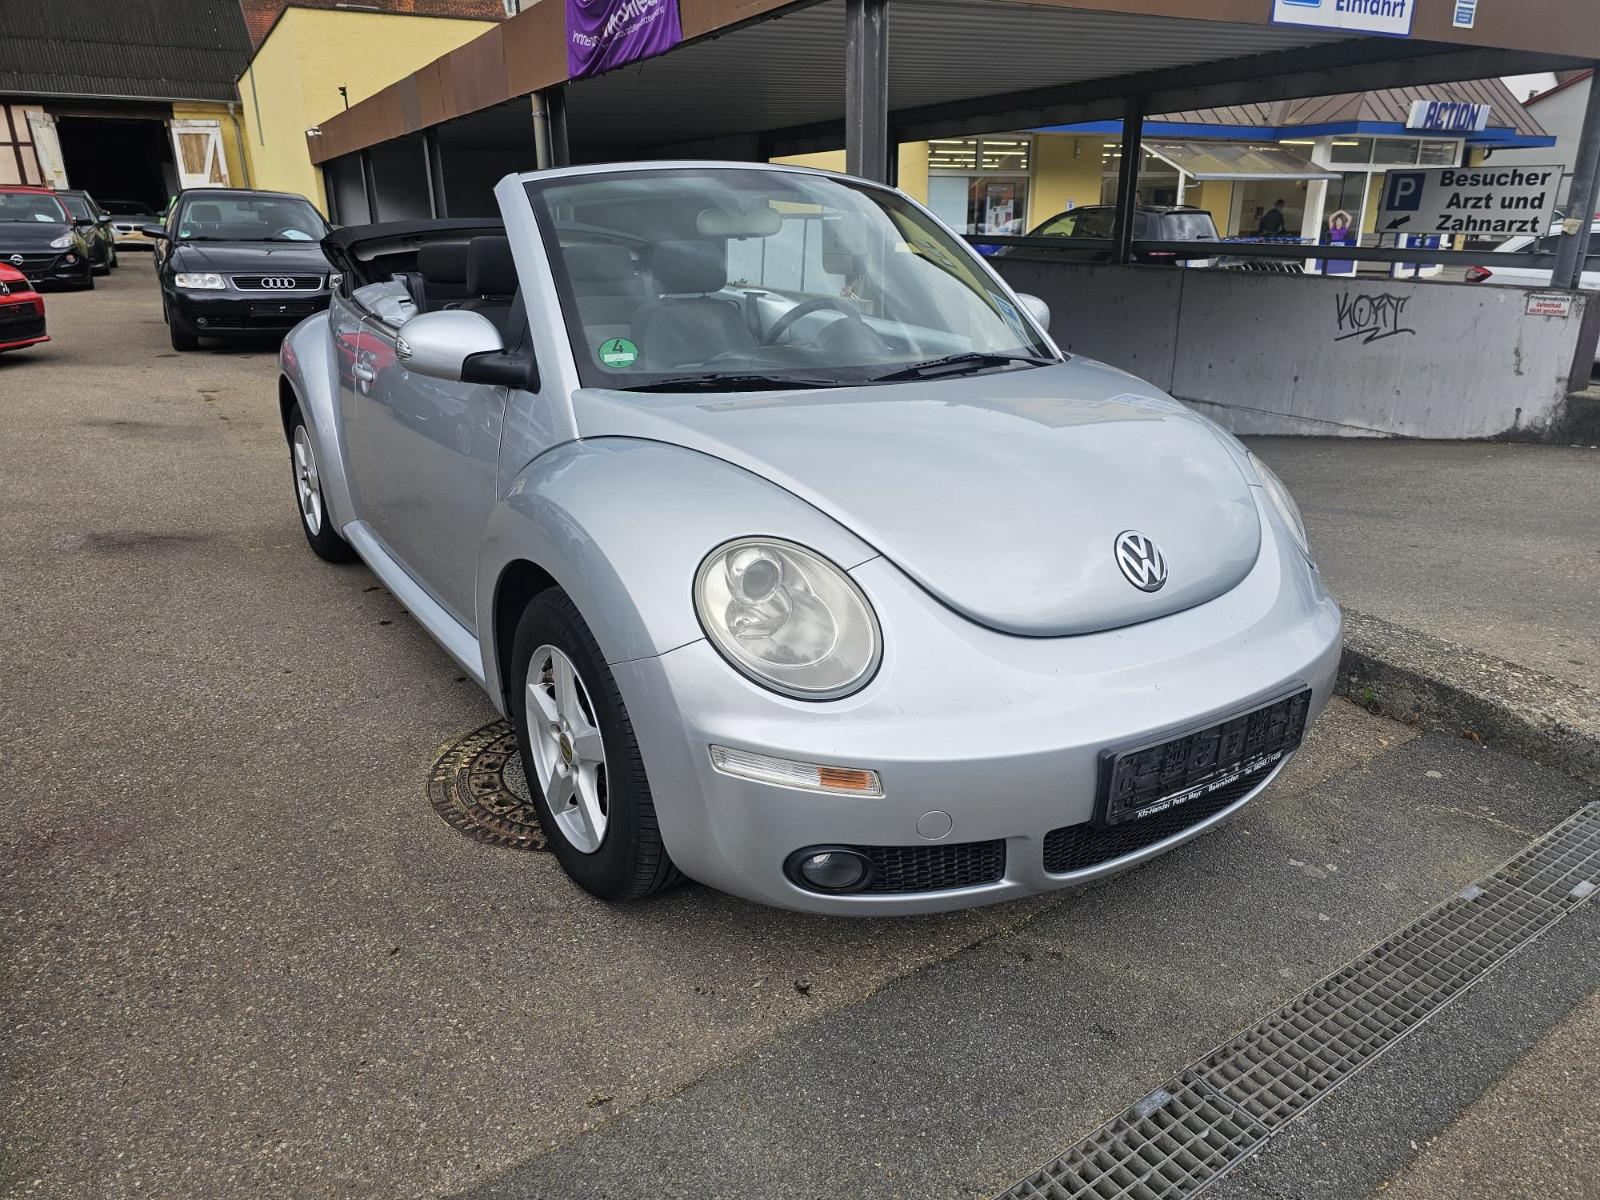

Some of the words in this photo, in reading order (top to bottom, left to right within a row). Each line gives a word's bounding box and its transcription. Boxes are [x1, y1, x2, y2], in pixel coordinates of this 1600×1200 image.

[1335, 0, 1406, 18] Einfahrt
[1423, 102, 1481, 129] ACTION
[1440, 170, 1552, 187] Besucher
[1445, 193, 1493, 209] Arzt
[1500, 192, 1546, 209] und
[1435, 214, 1540, 232] Zahnarzt
[612, 339, 624, 353] 4
